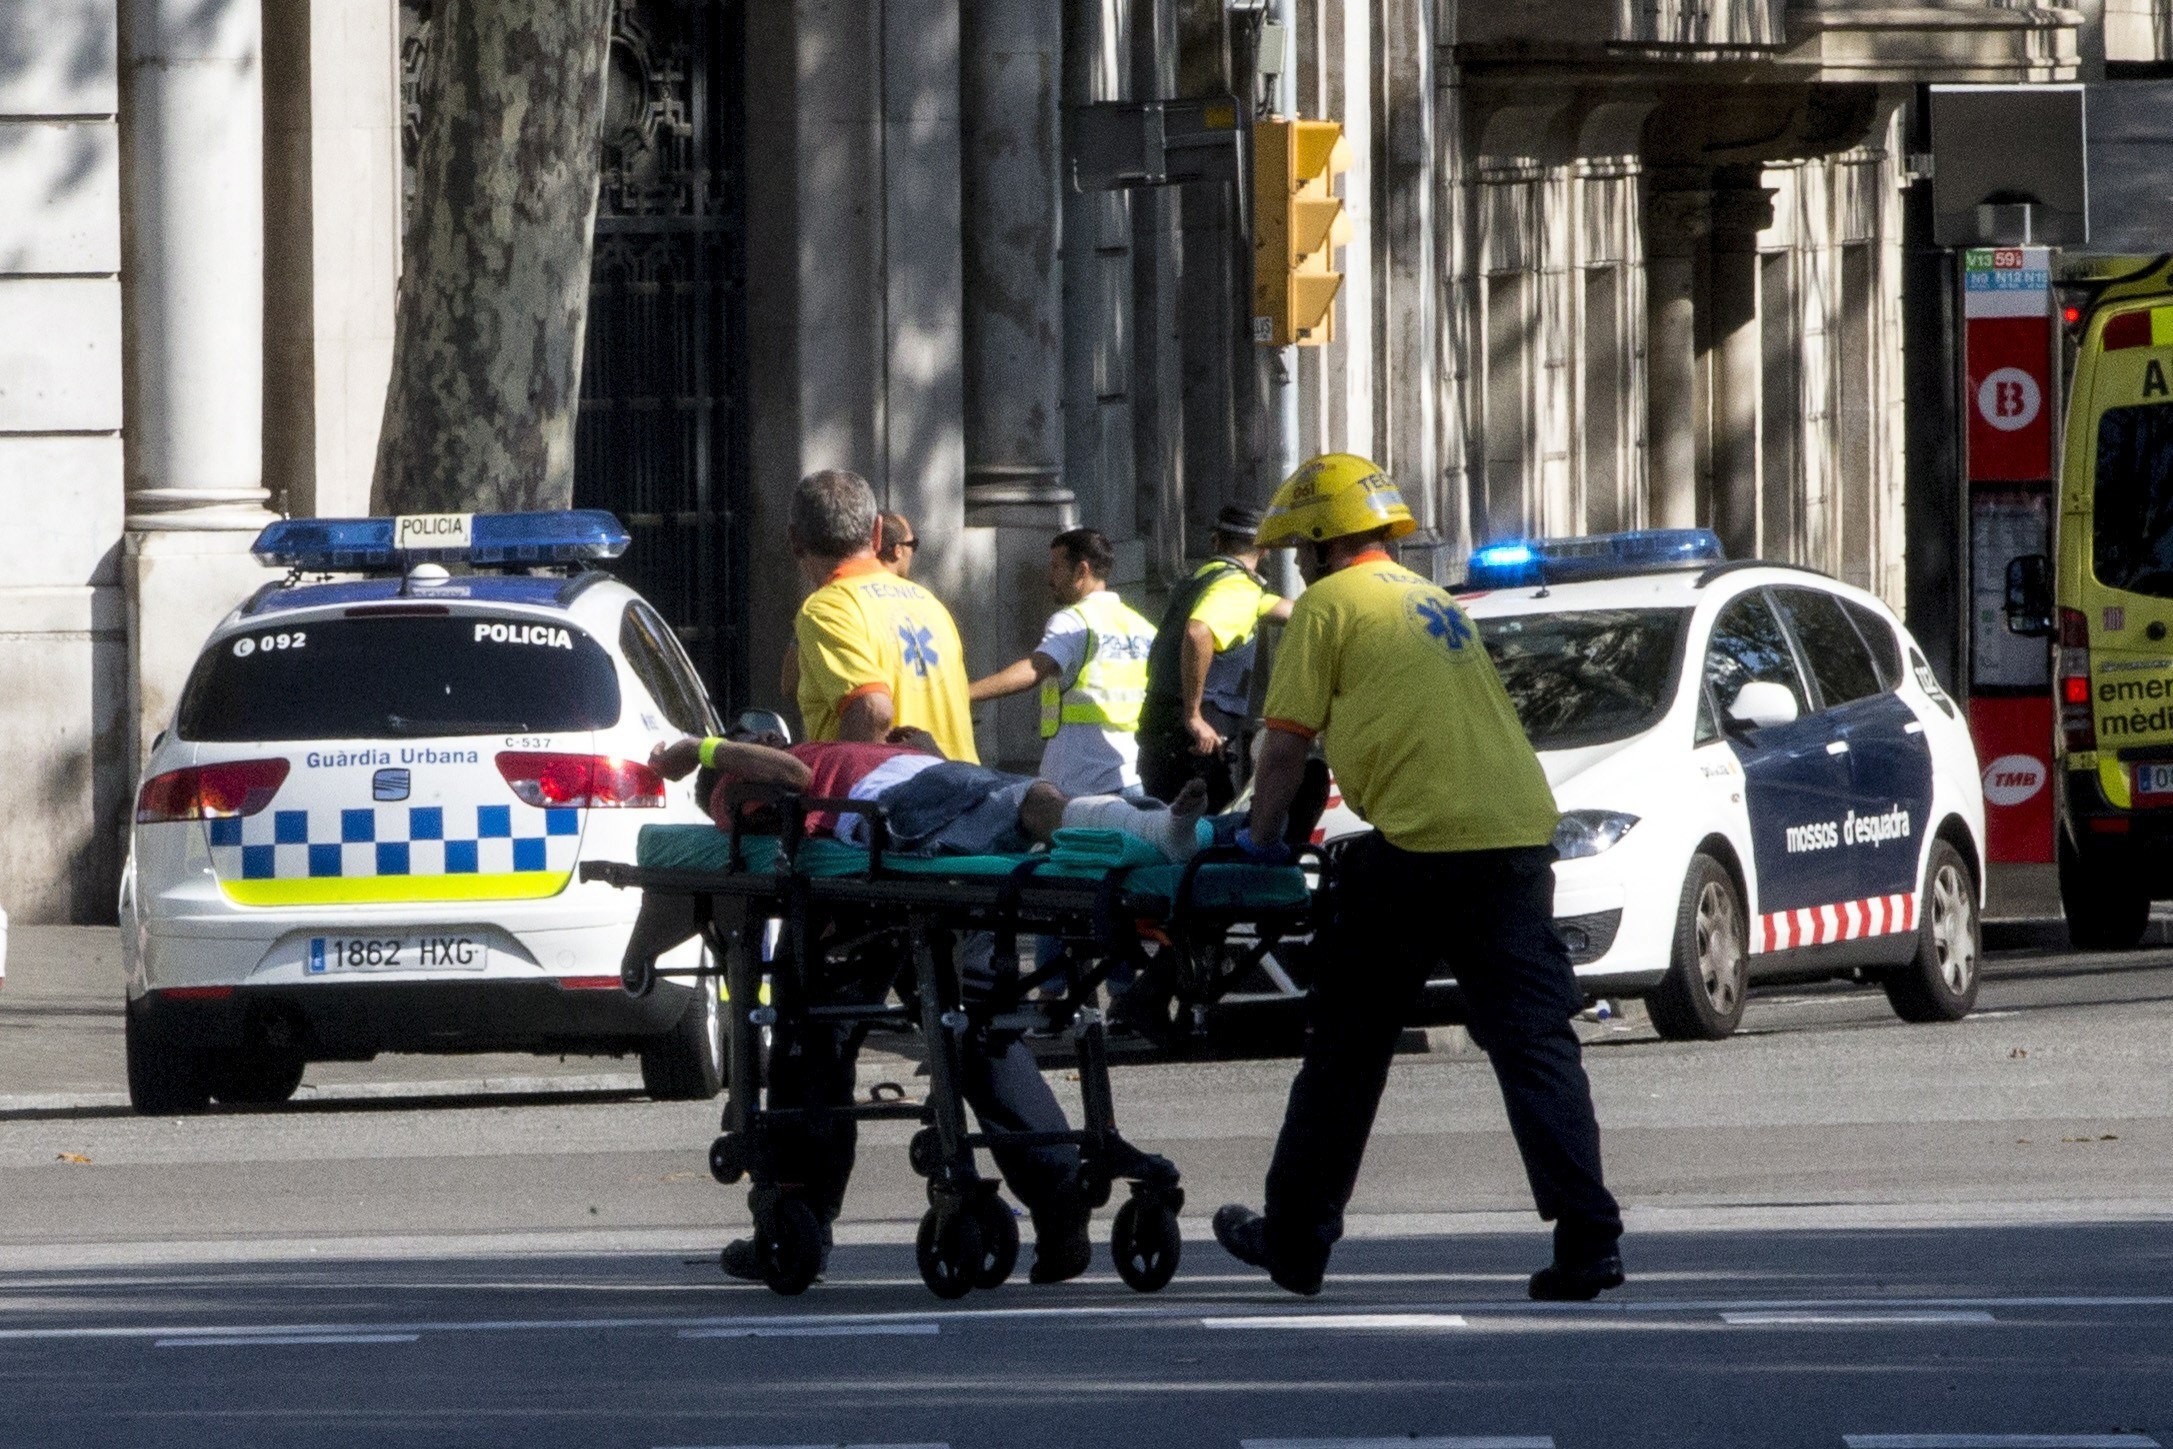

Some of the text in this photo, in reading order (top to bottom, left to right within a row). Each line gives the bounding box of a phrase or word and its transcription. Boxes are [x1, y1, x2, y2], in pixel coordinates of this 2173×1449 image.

[1966, 253, 1993, 267] V13
[1996, 381, 2025, 418] B
[401, 518, 464, 535] POLICIA
[260, 632, 307, 652] 092
[474, 623, 574, 649] POLICIA
[2099, 679, 2173, 701] emer
[505, 737, 551, 749] C-537
[306, 748, 479, 768] Guàrdia Urbana
[1995, 771, 2038, 788] TMB
[2155, 767, 2173, 788] 0
[1786, 803, 1911, 853] mossos d'esquadra
[334, 939, 400, 967] 1862
[420, 937, 473, 966] HXG
